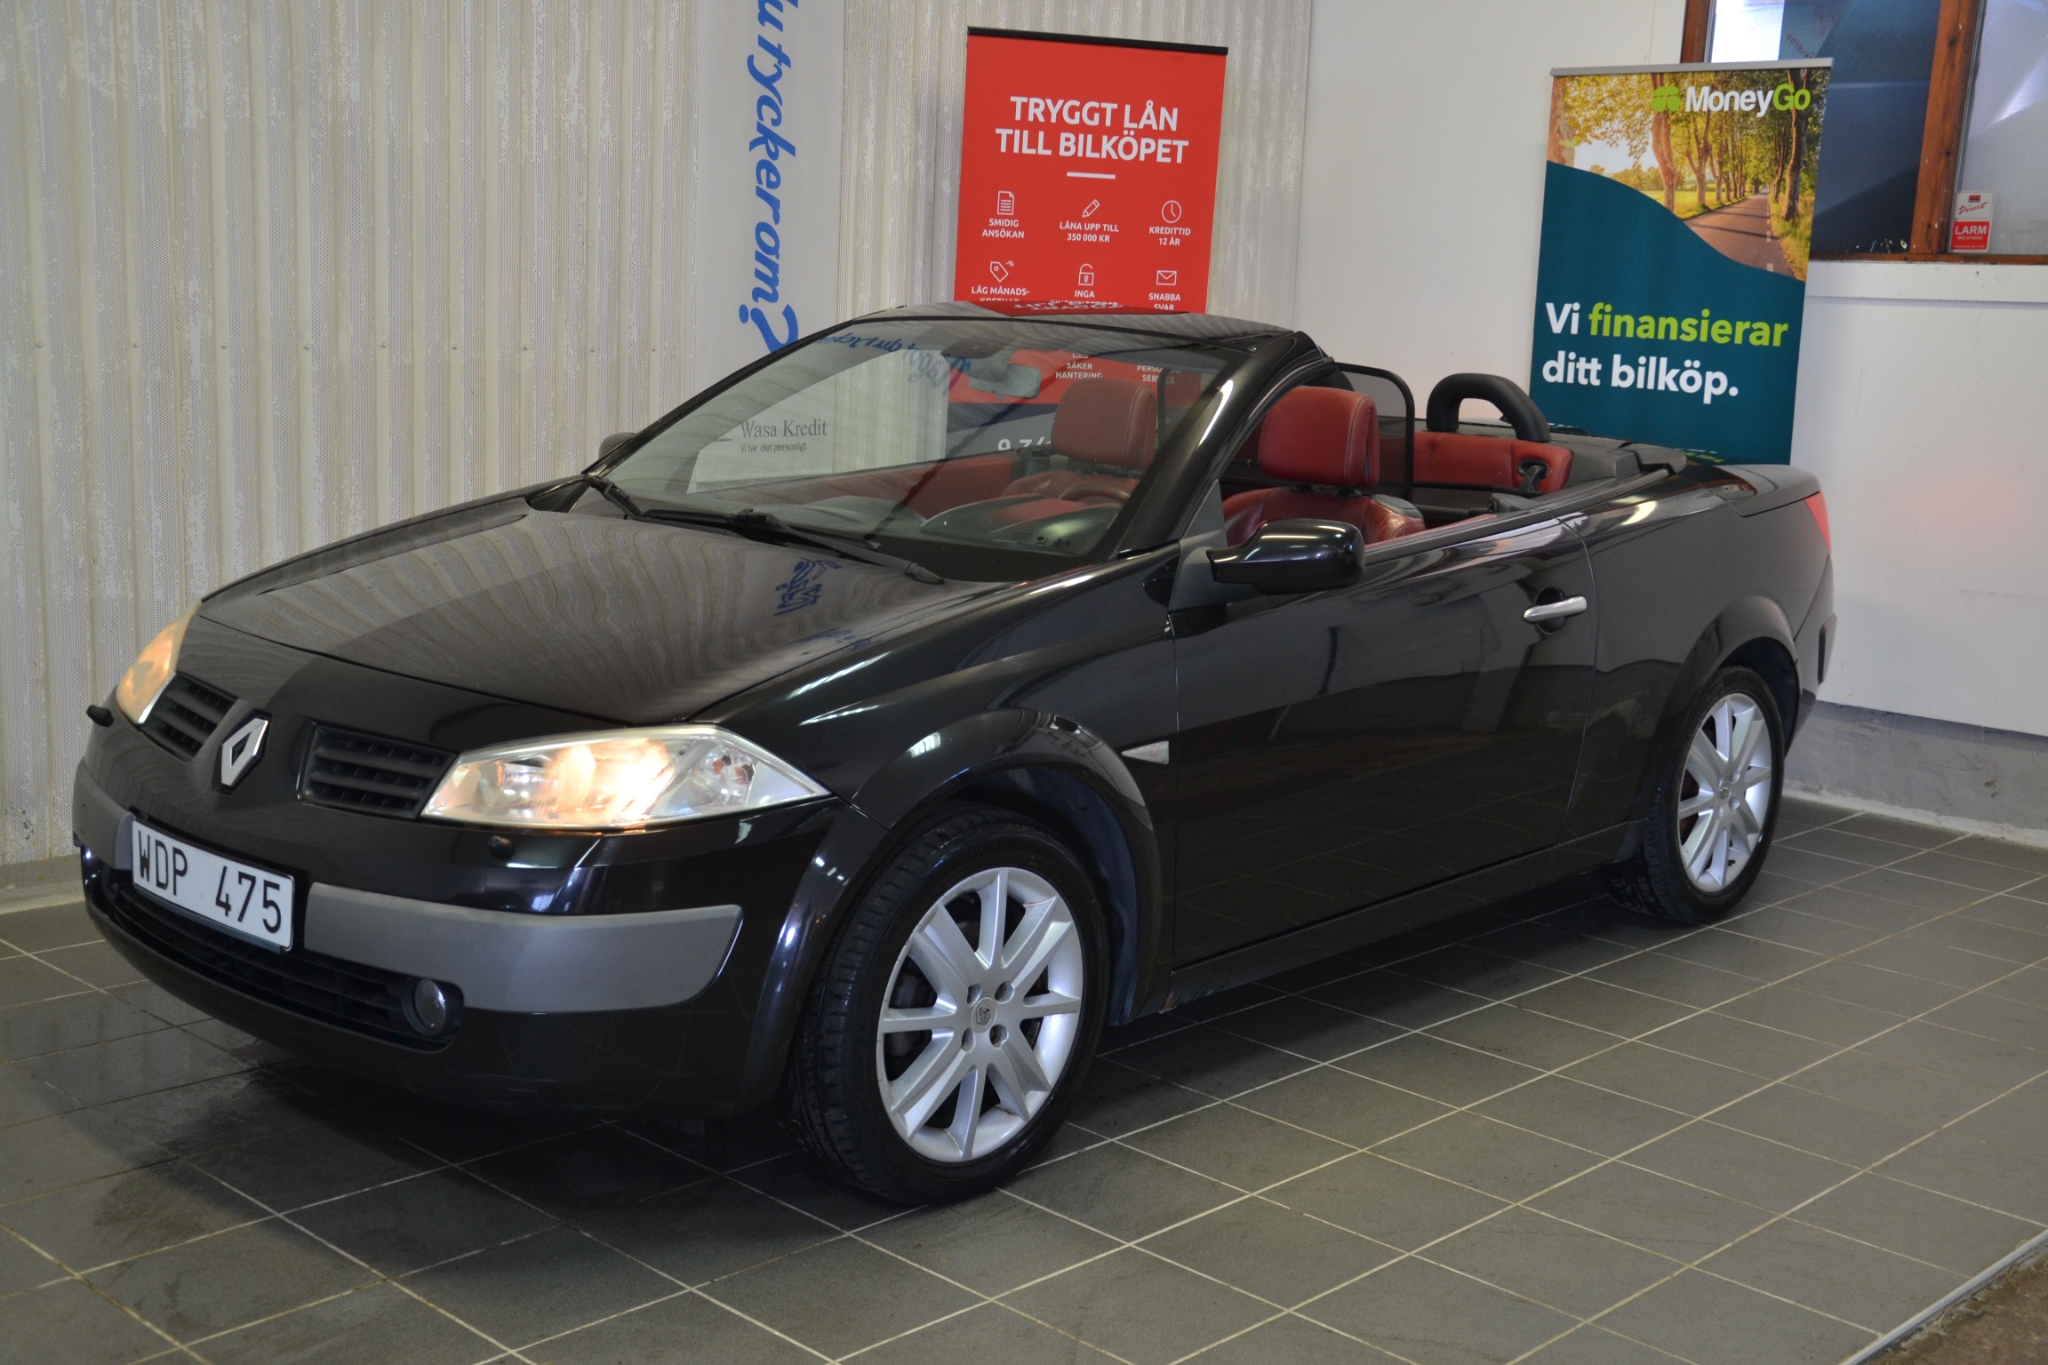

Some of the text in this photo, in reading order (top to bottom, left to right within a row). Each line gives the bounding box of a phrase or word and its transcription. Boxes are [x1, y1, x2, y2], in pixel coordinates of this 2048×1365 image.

[1685, 83, 1811, 118] MoneyGo
[1010, 96, 1178, 131] TRYGGT LÅN
[995, 128, 1189, 164] TILL BILKÖPET
[988, 218, 1019, 228] SMIDIG
[1059, 220, 1119, 233] LÅNA UPP TILL
[982, 228, 1025, 239] ANSÖKAN
[1149, 226, 1191, 236] KREDITTID
[1955, 226, 1987, 235] LARM
[1067, 233, 1110, 243] 350 000 KR
[1158, 236, 1181, 246] 12 ÅR
[971, 284, 1030, 296] LÅG MÅNADS-
[1074, 290, 1095, 299] INGA
[1148, 292, 1181, 302] SNABBA
[1545, 302, 1789, 347] Vi finansierar
[1066, 361, 1093, 370] SÄKER
[1542, 350, 1739, 405] ditt bilköp.
[741, 419, 828, 438] Wasa Kredit
[760, 443, 772, 452] det
[138, 830, 281, 934] WDP 475
